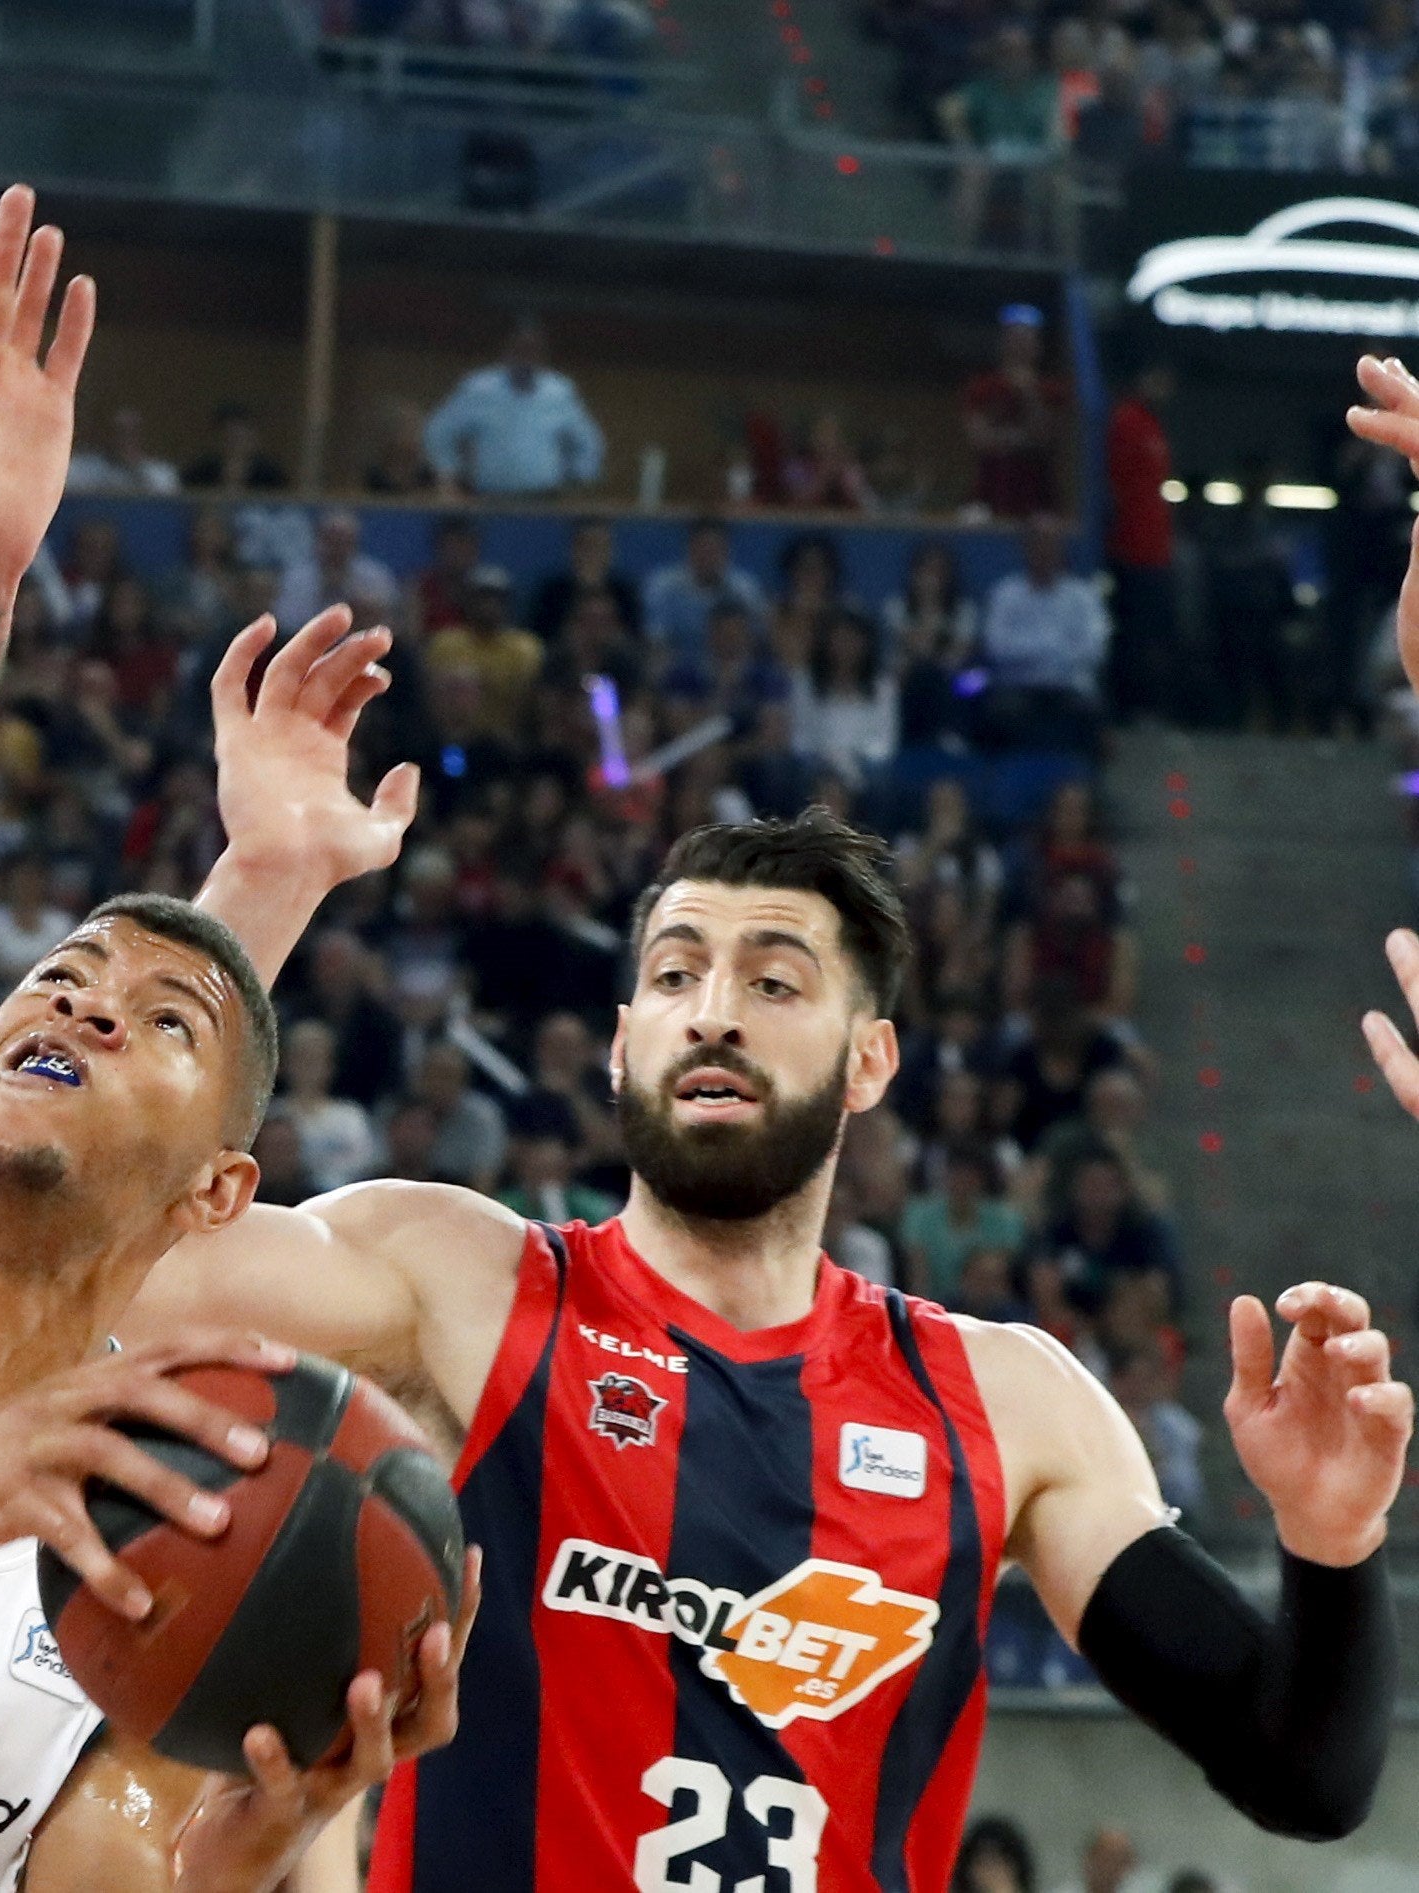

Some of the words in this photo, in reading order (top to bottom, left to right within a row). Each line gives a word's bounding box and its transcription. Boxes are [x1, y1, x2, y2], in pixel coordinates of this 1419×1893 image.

[578, 1323, 690, 1374] KELME
[556, 1550, 879, 1681] KIROLBET
[633, 1756, 830, 1893] 23
